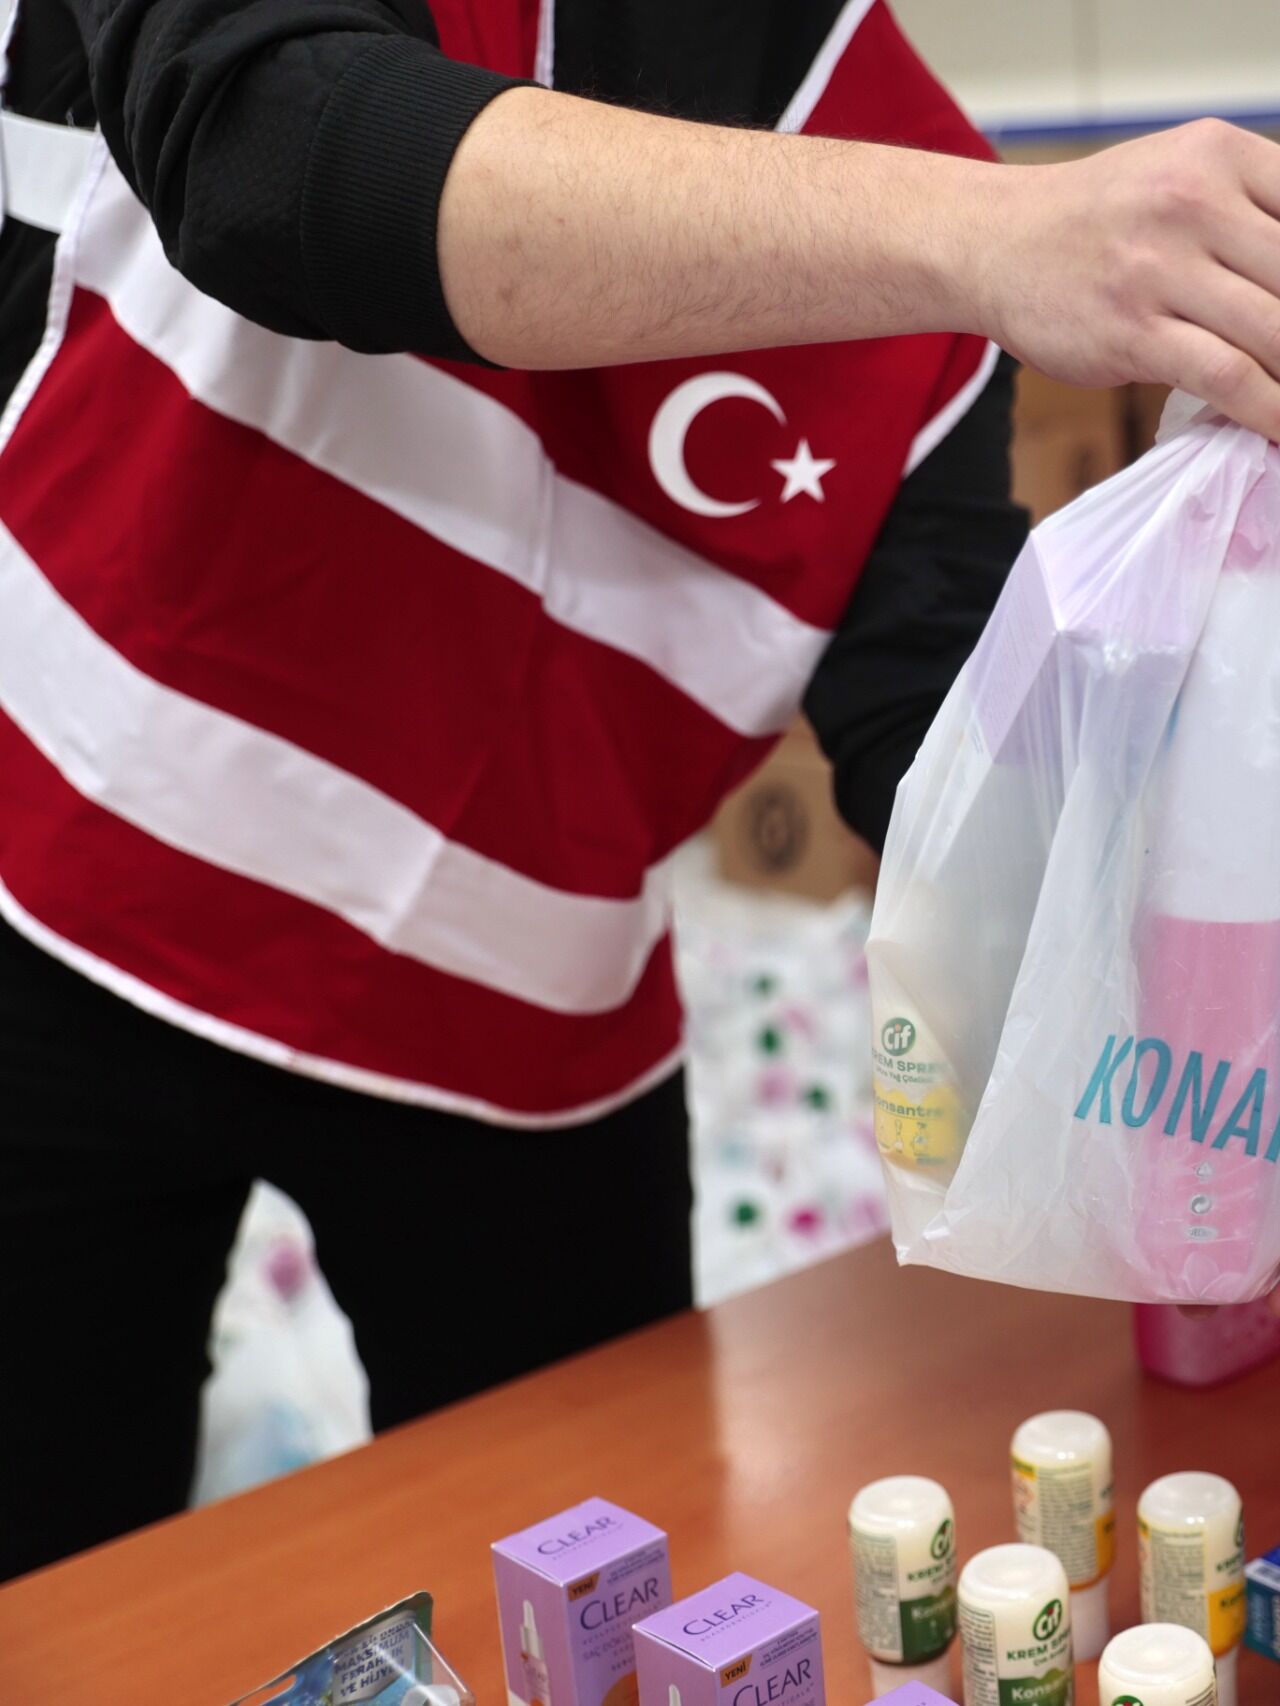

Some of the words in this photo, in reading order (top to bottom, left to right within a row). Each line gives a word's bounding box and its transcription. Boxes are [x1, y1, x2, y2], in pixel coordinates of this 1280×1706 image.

[883, 1023, 912, 1050] Cif
[537, 1516, 617, 1555] CLEAR
[580, 1577, 660, 1631] CLEAR
[683, 1594, 764, 1635] CLEAR
[725, 1661, 746, 1681] YENİ
[733, 1658, 812, 1706] CLEAR
